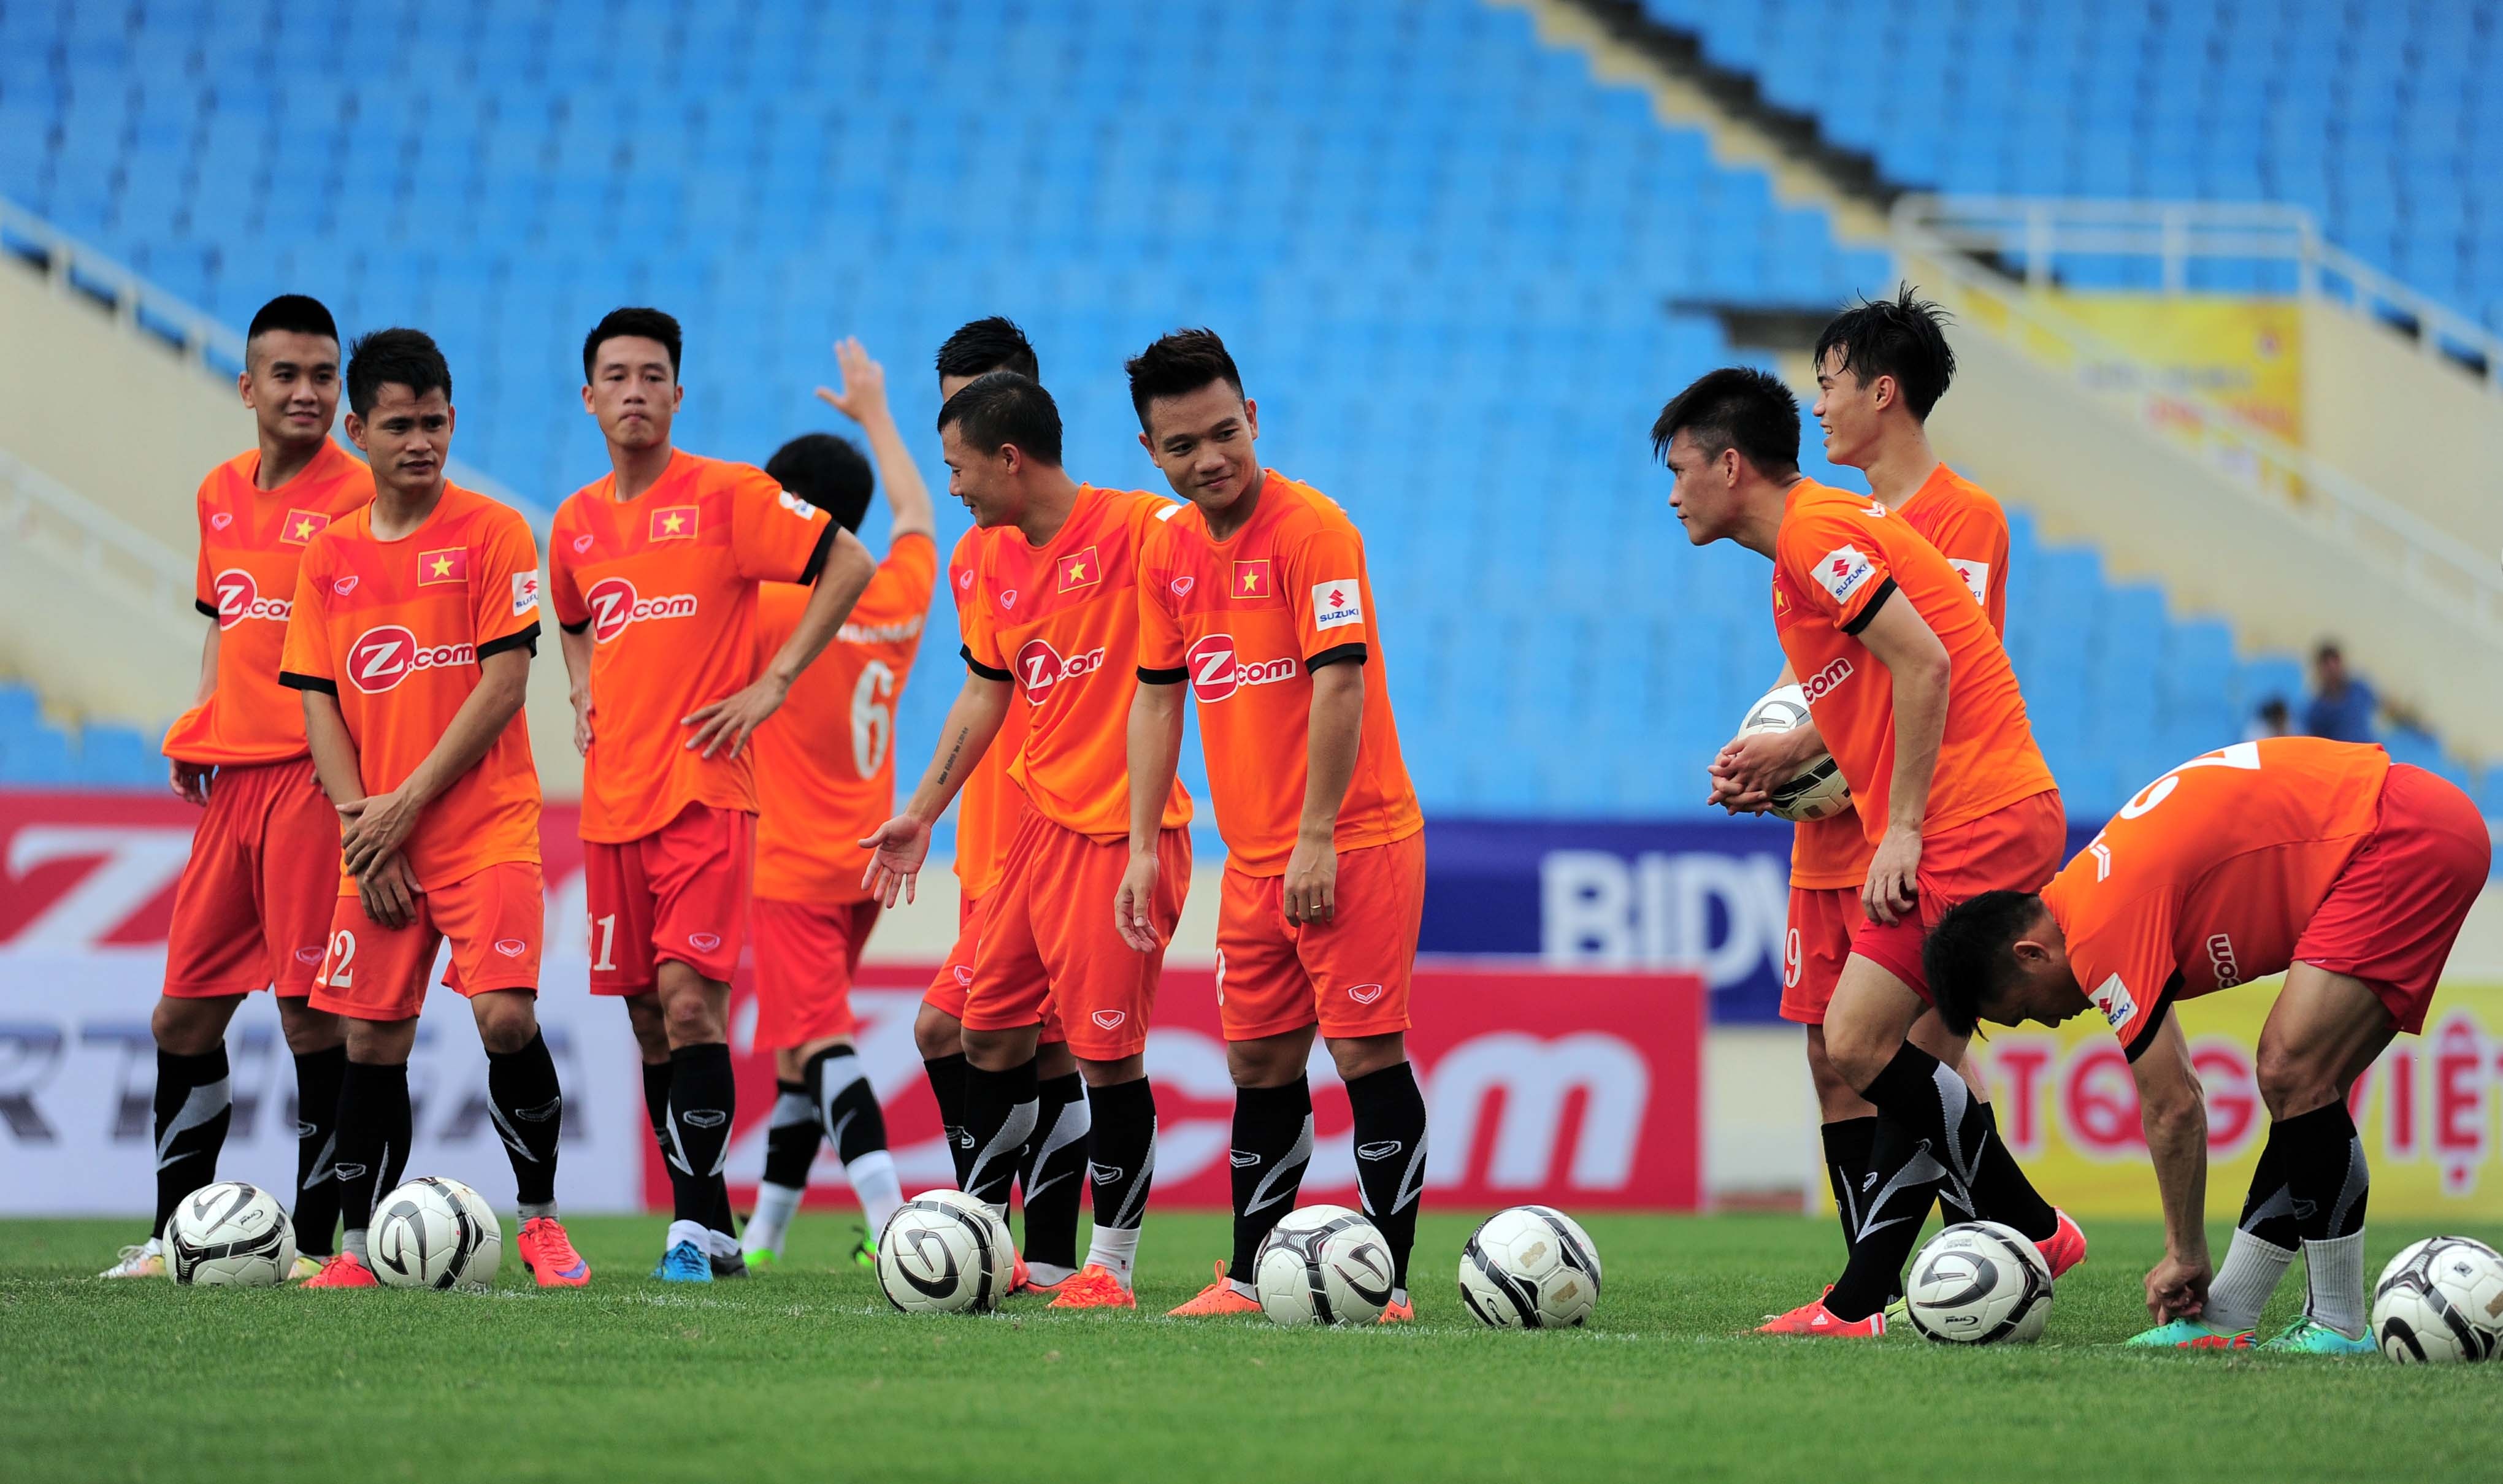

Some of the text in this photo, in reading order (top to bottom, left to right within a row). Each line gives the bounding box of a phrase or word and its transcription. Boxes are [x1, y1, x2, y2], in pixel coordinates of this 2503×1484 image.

[216, 581, 293, 619] Z.co
[1835, 564, 1868, 596] SUZUKI
[591, 589, 696, 632] Z.com
[1319, 608, 1359, 622] SUZUKI
[358, 638, 474, 683] Z.com
[1192, 647, 1294, 688] Zcom
[1802, 659, 1852, 703] com
[851, 659, 894, 779] 6
[588, 912, 616, 971] 1
[1784, 927, 1801, 989] 9
[1965, 1045, 2257, 1154] TQG
